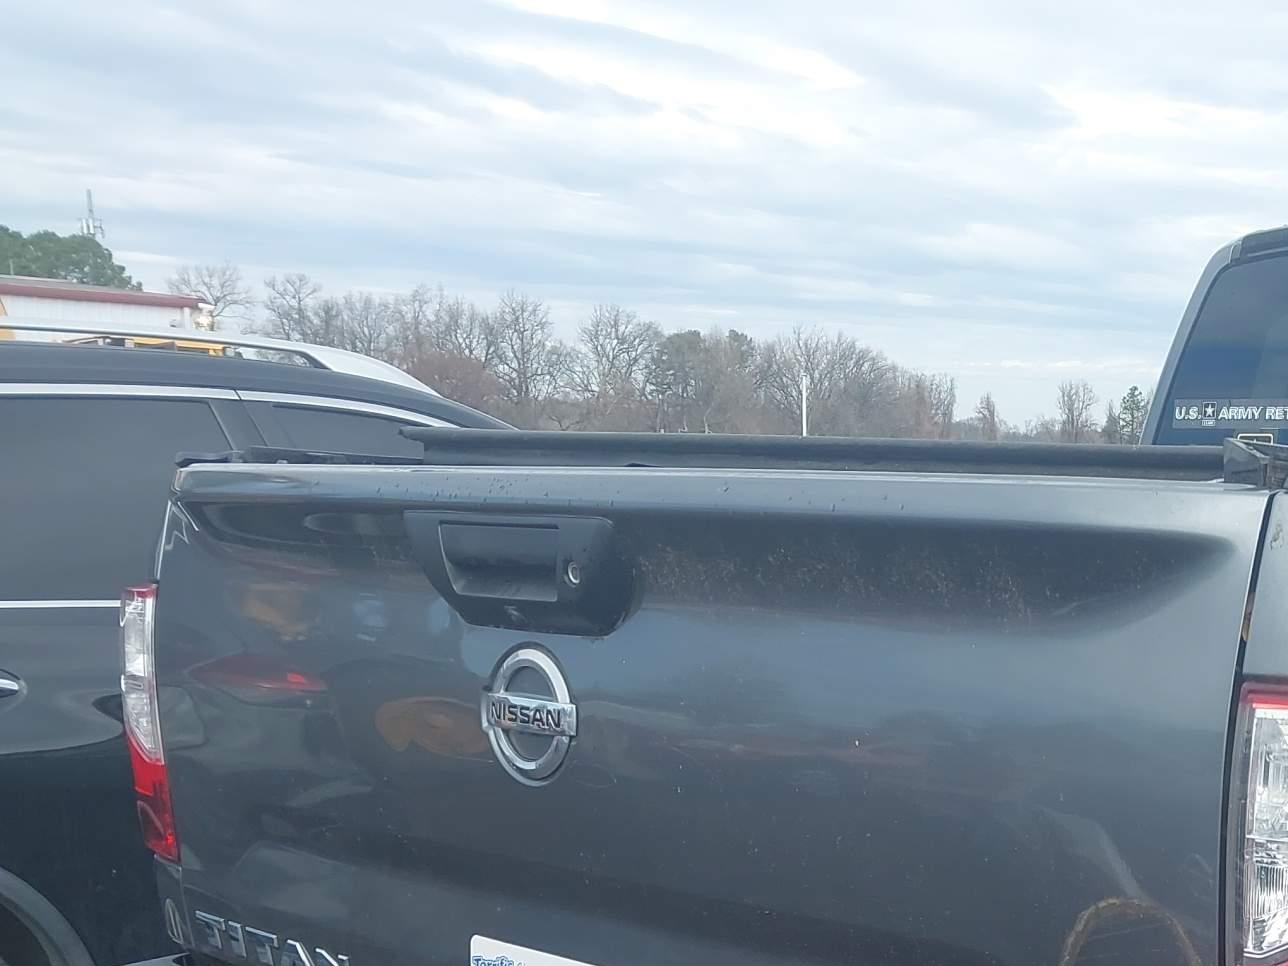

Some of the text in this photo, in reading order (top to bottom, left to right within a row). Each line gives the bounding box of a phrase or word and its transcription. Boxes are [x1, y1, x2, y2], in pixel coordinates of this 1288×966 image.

[1175, 406, 1201, 420] U.S.
[1218, 406, 1263, 421] ARMY
[490, 701, 561, 729] NISSAN
